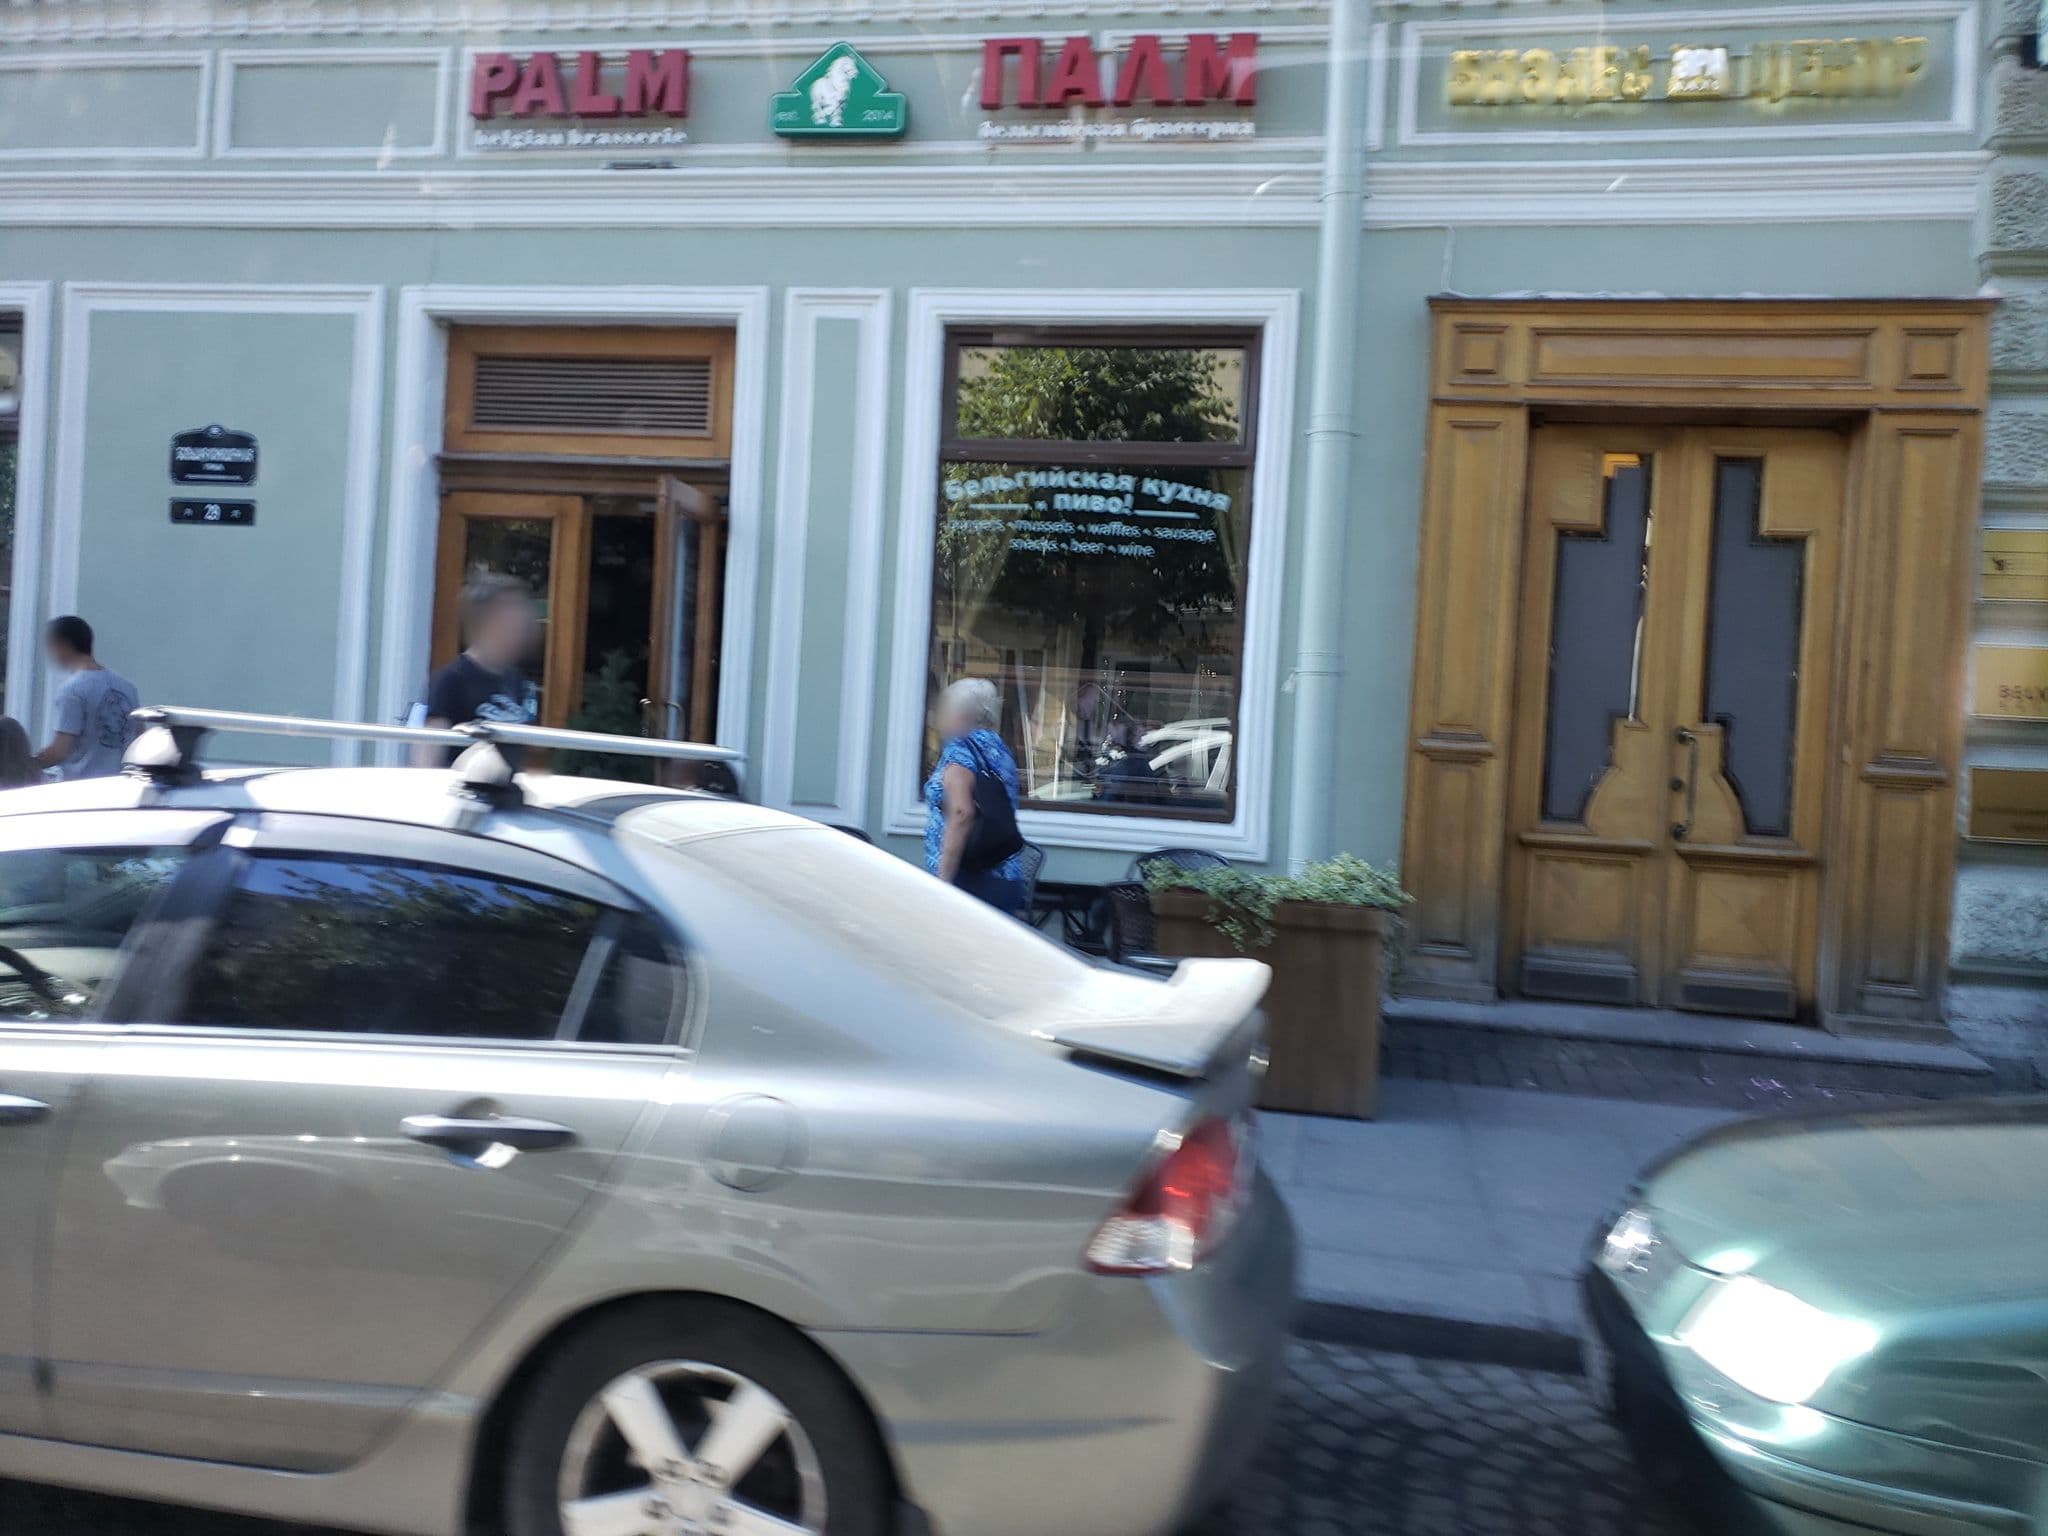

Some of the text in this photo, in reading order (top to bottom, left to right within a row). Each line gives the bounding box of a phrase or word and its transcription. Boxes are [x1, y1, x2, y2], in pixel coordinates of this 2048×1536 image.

[470, 48, 691, 119] PALM
[980, 33, 1259, 110] ПАЛМ
[1053, 492, 1135, 516] пиво!
[1141, 476, 1232, 512] кухня
[1070, 538, 1105, 553] beer
[1153, 526, 1217, 544] sausage
